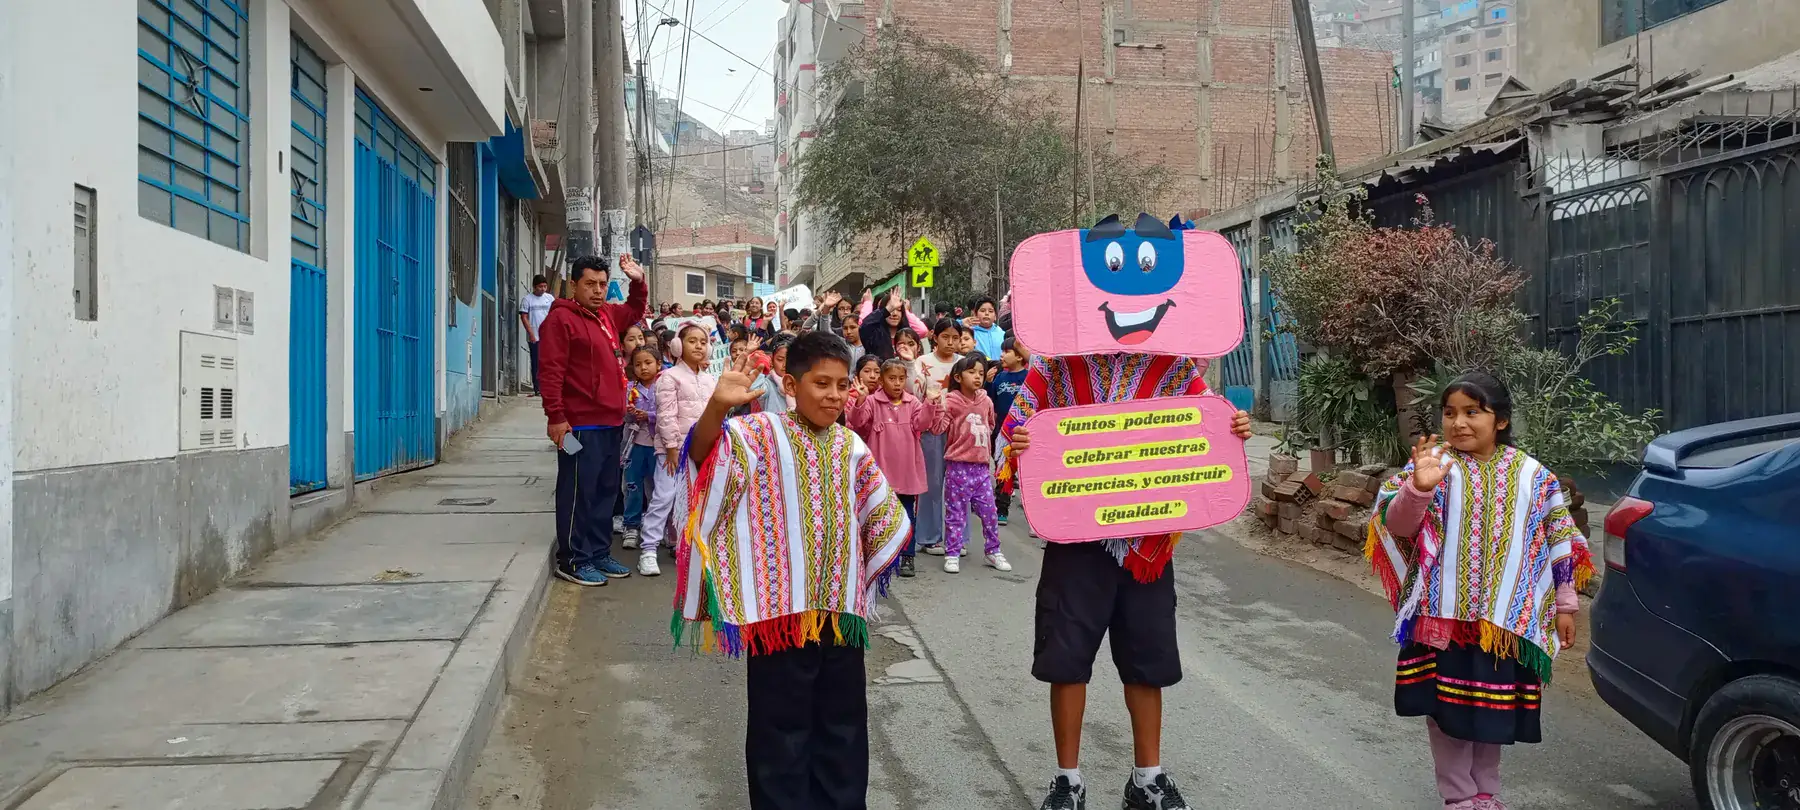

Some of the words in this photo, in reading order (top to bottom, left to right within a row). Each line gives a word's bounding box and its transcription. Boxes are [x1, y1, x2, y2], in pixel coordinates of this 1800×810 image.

[606, 281, 624, 301] A
[1123, 411, 1193, 430] podemos
[1066, 448, 1132, 465] celebrar
[1139, 441, 1206, 457] nuestras
[1046, 477, 1138, 495] diferencias,
[1141, 476, 1152, 489] y
[1154, 467, 1227, 484] construir
